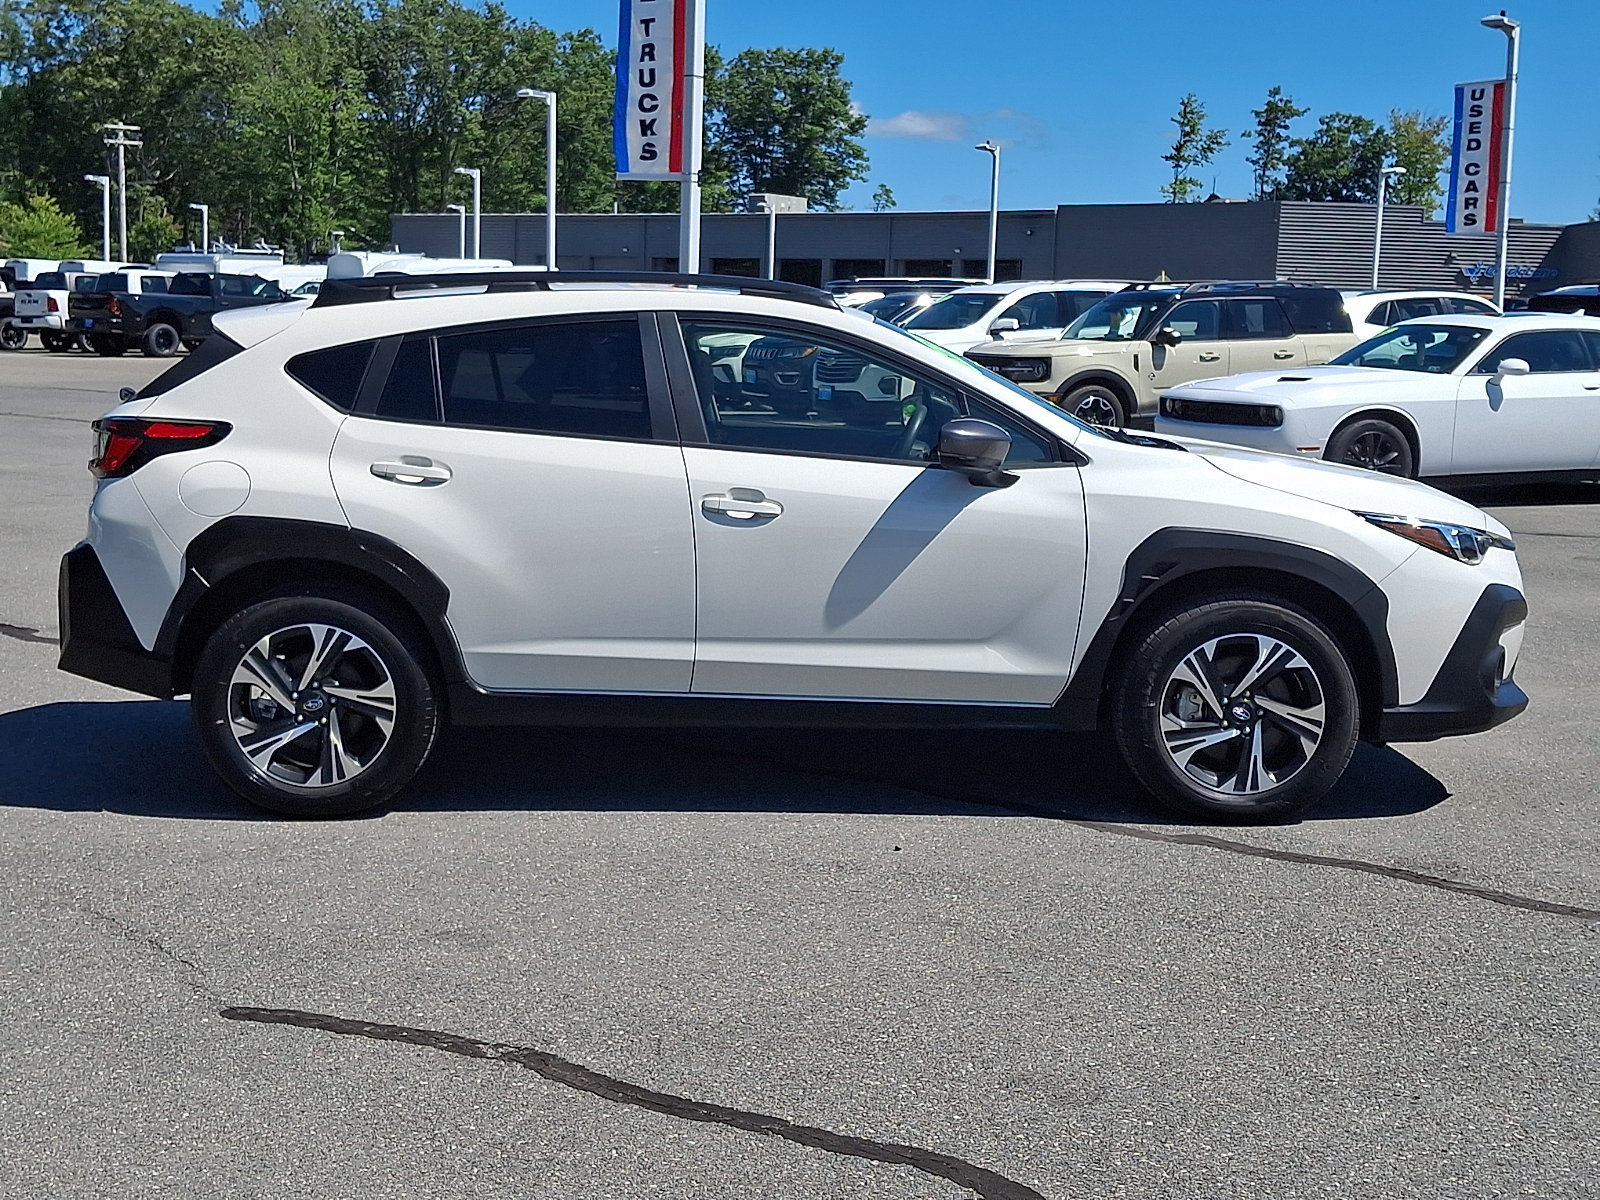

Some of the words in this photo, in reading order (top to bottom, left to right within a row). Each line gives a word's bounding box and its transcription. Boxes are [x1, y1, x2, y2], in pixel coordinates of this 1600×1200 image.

[638, 18, 659, 161] TRUCKS
[1466, 88, 1485, 151] USED
[1463, 162, 1481, 226] CARS
